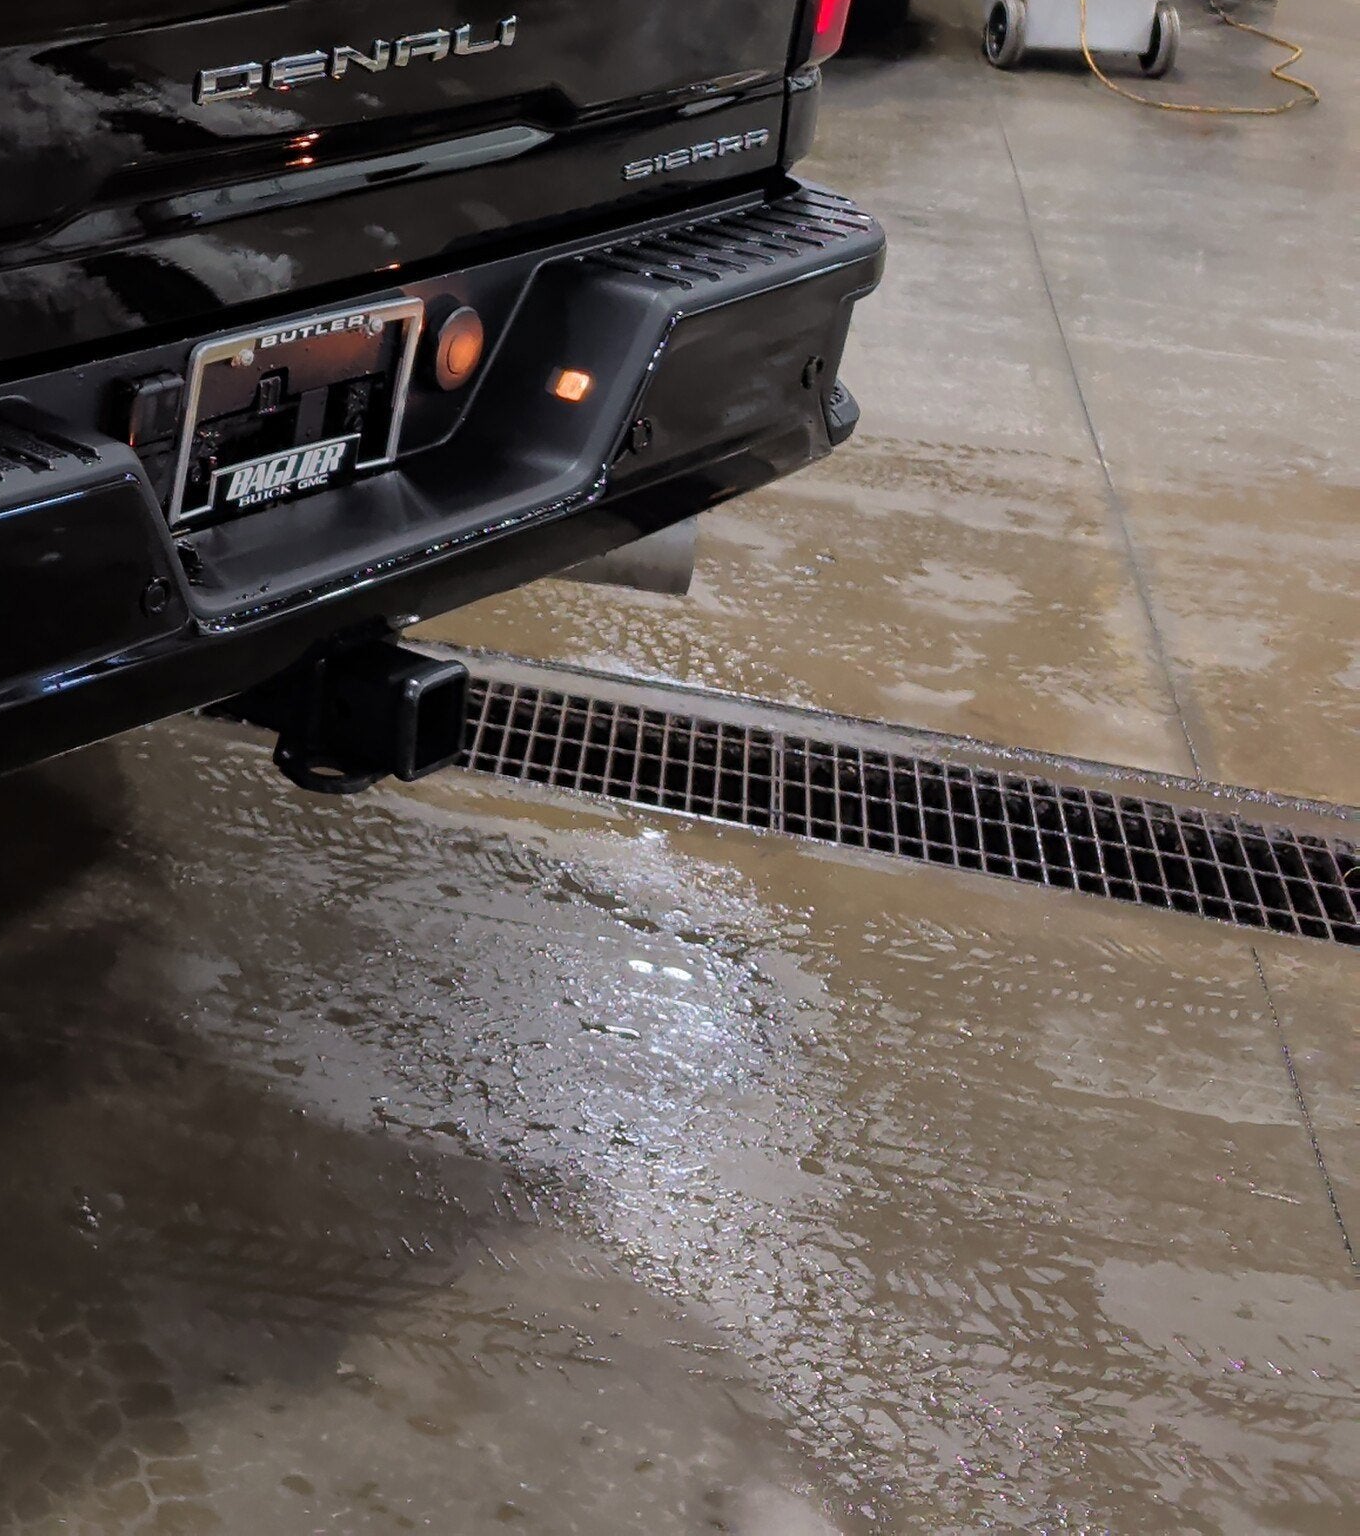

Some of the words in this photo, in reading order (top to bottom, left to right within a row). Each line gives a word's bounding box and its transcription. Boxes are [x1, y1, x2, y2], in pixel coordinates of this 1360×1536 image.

[193, 14, 517, 105] DENALI
[622, 127, 770, 182] SIERRA
[261, 314, 364, 348] BUTLER
[226, 443, 346, 501] BAGLIER
[239, 484, 291, 507] BUICK
[297, 473, 329, 490] GMC
